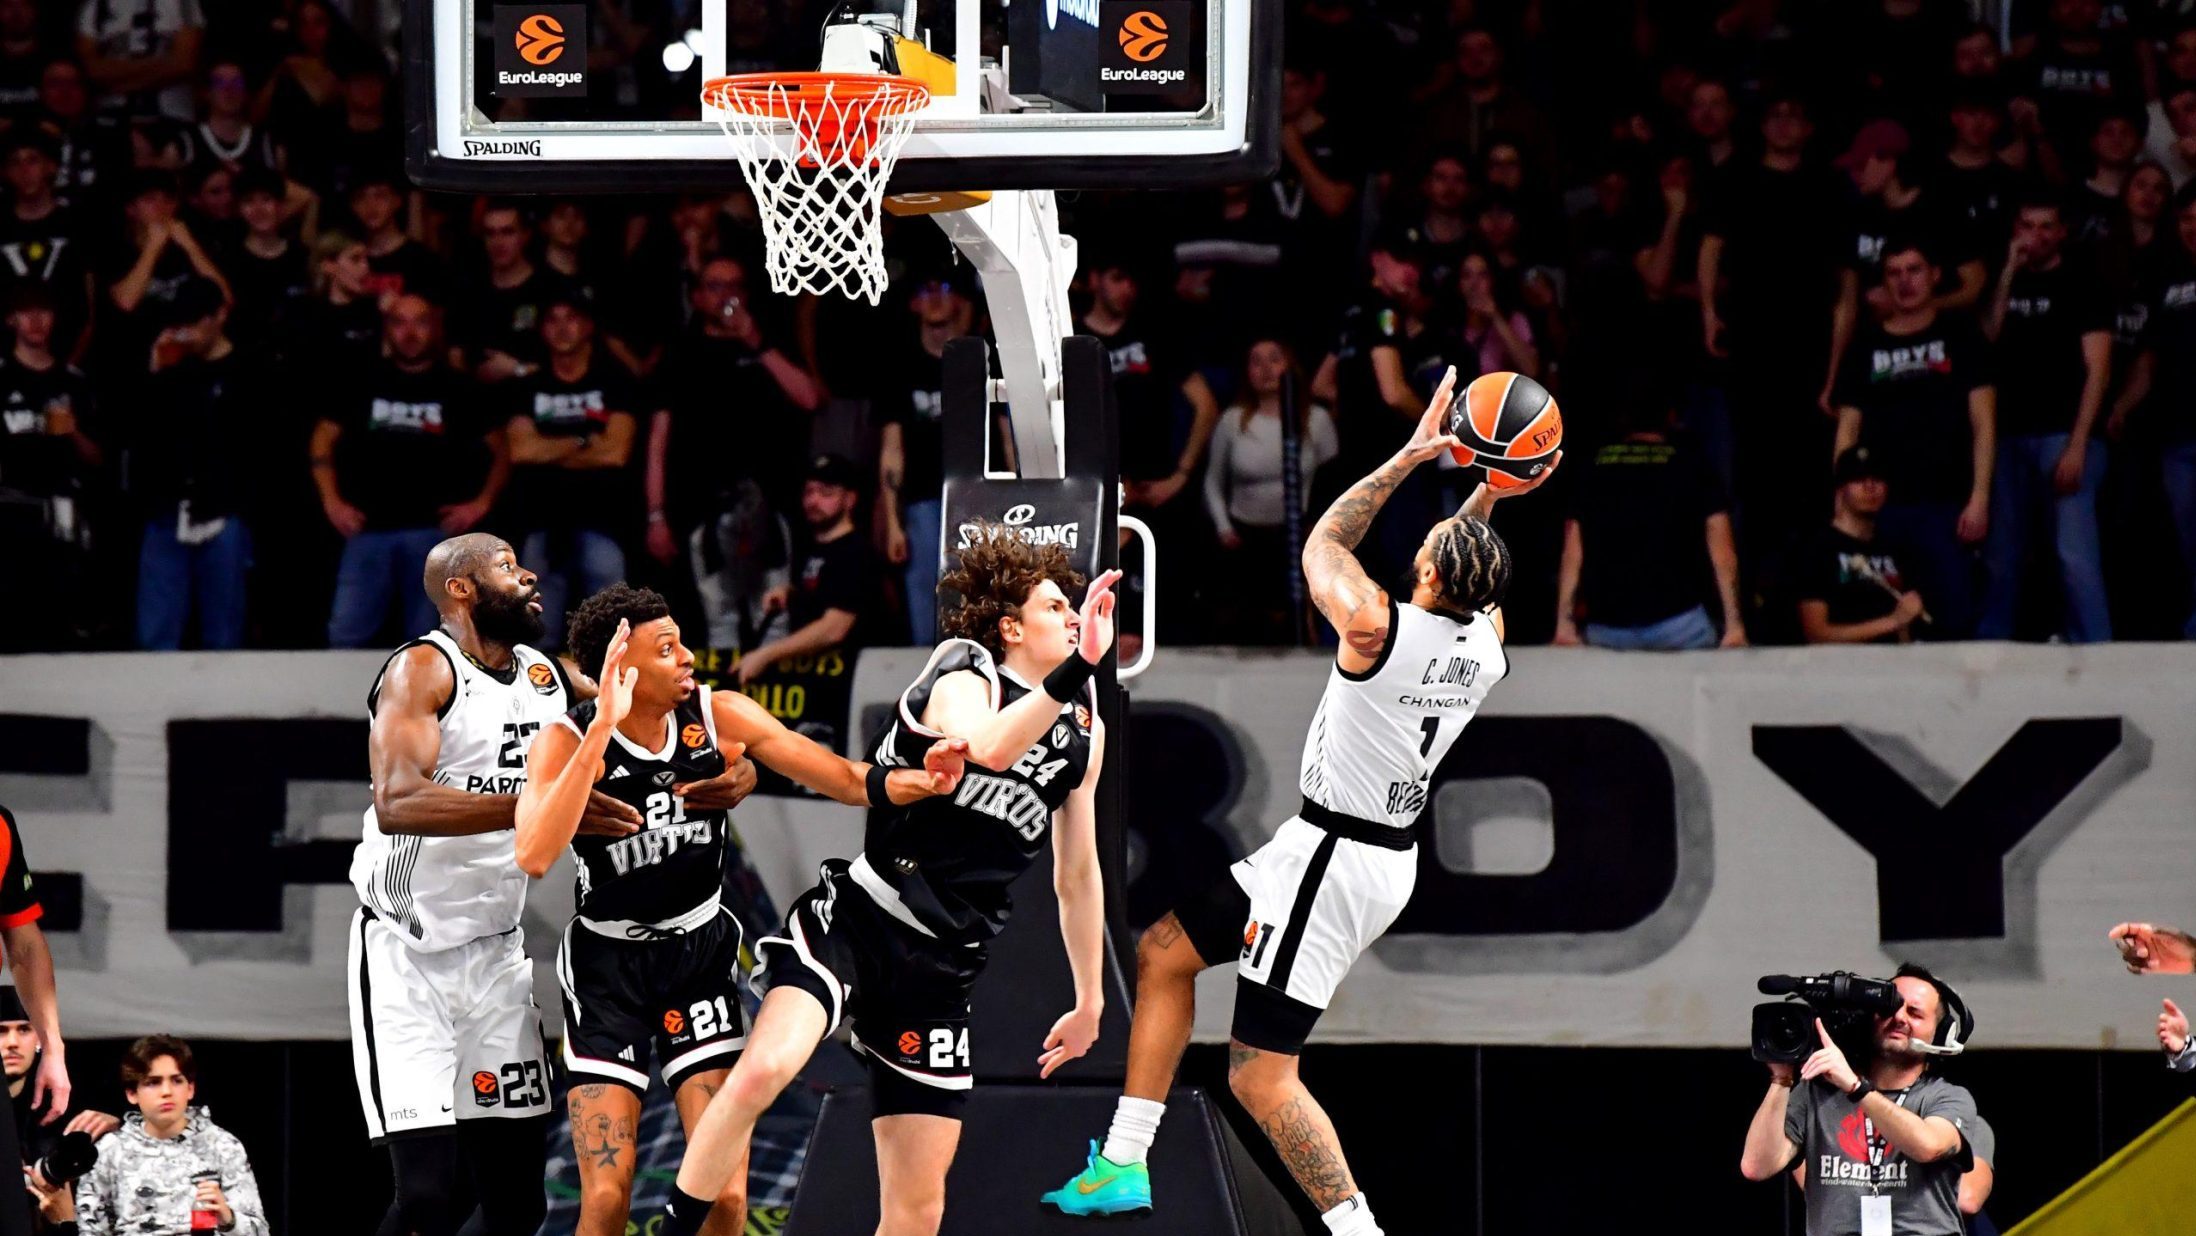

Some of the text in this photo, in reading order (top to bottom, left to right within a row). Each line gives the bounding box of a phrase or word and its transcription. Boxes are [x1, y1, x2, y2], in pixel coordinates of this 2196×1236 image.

[498, 71, 583, 87] EuroLeague
[1100, 67, 1186, 84] EuroLeague
[463, 140, 541, 157] SPALDING
[1421, 656, 1480, 688] C. JONES
[1399, 695, 1471, 708] CHANGAN
[1011, 743, 1068, 787] 24
[646, 791, 687, 830] 21
[1252, 922, 1275, 969] 1
[689, 995, 732, 1041] 21
[929, 1027, 970, 1068] 24
[500, 1059, 546, 1109] 23
[390, 1108, 418, 1121] mts
